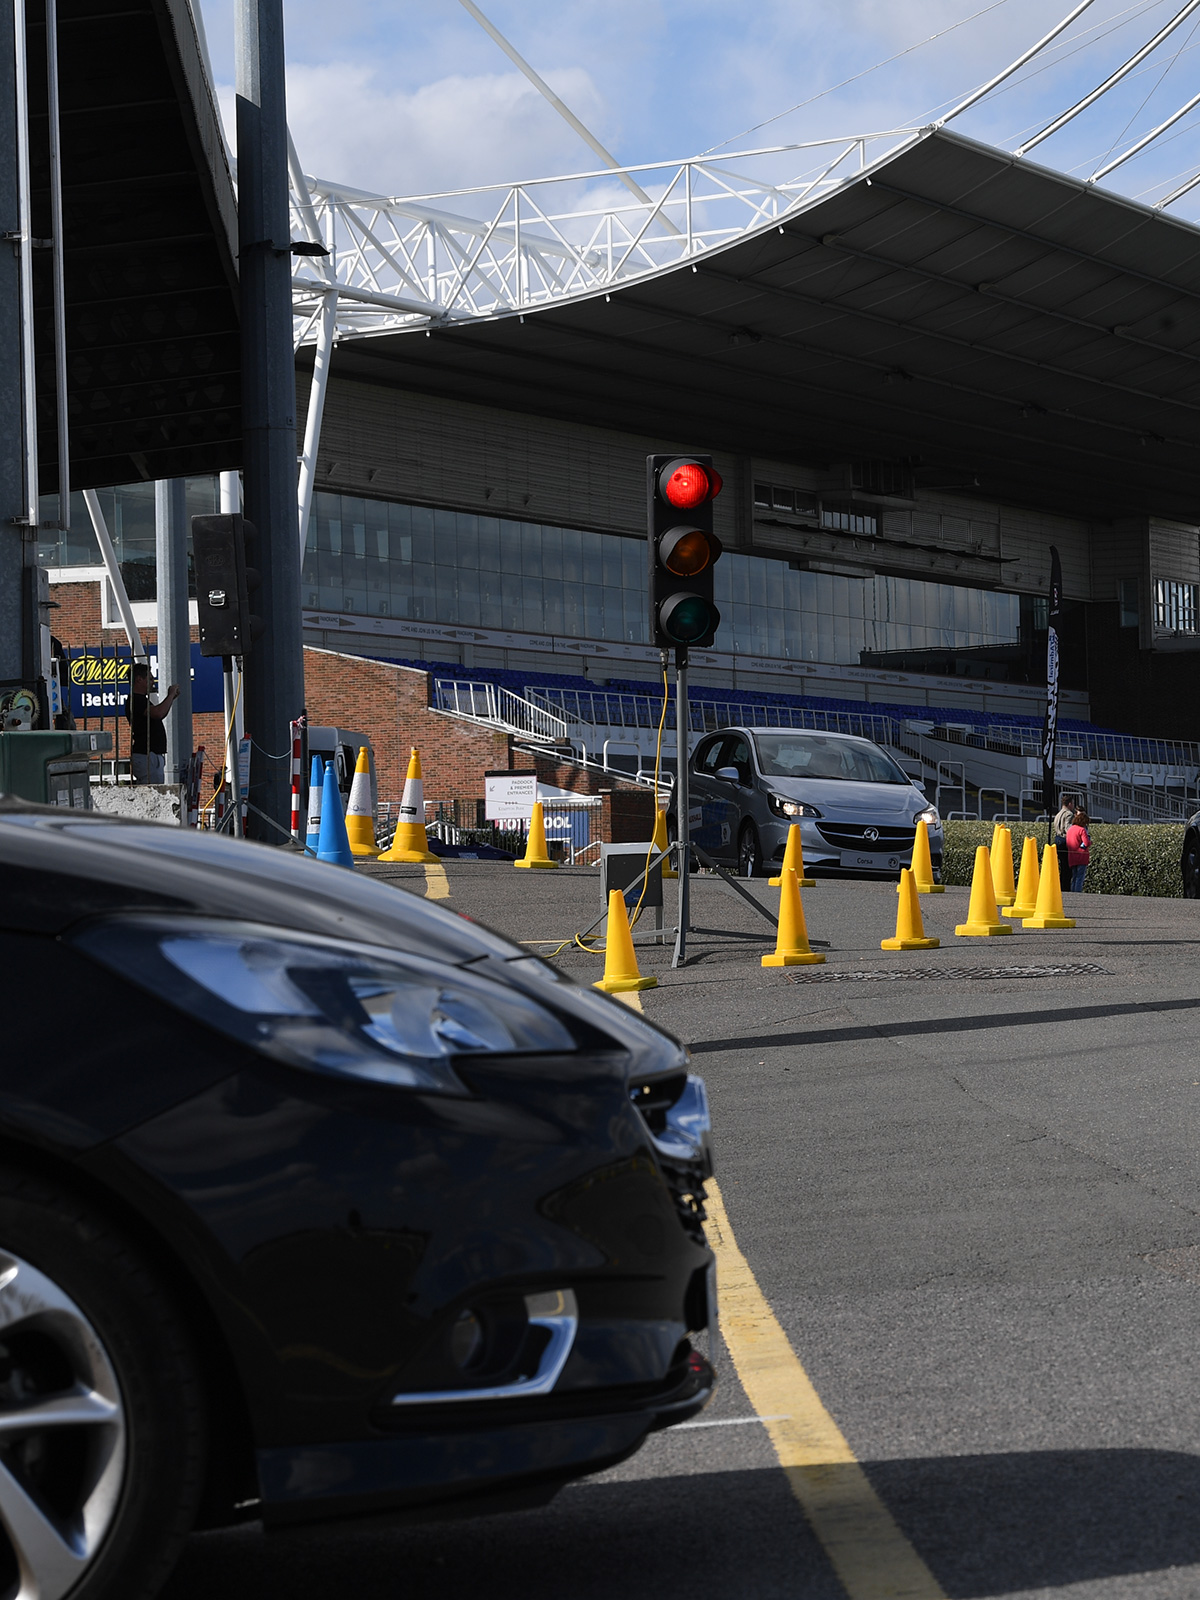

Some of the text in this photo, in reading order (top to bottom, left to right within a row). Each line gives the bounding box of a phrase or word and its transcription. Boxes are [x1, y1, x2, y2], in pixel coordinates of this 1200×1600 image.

[71, 656, 130, 683] Willia
[81, 692, 128, 706] Bettin
[498, 816, 572, 831] TOTEOOL
[857, 857, 873, 865] Corsa
